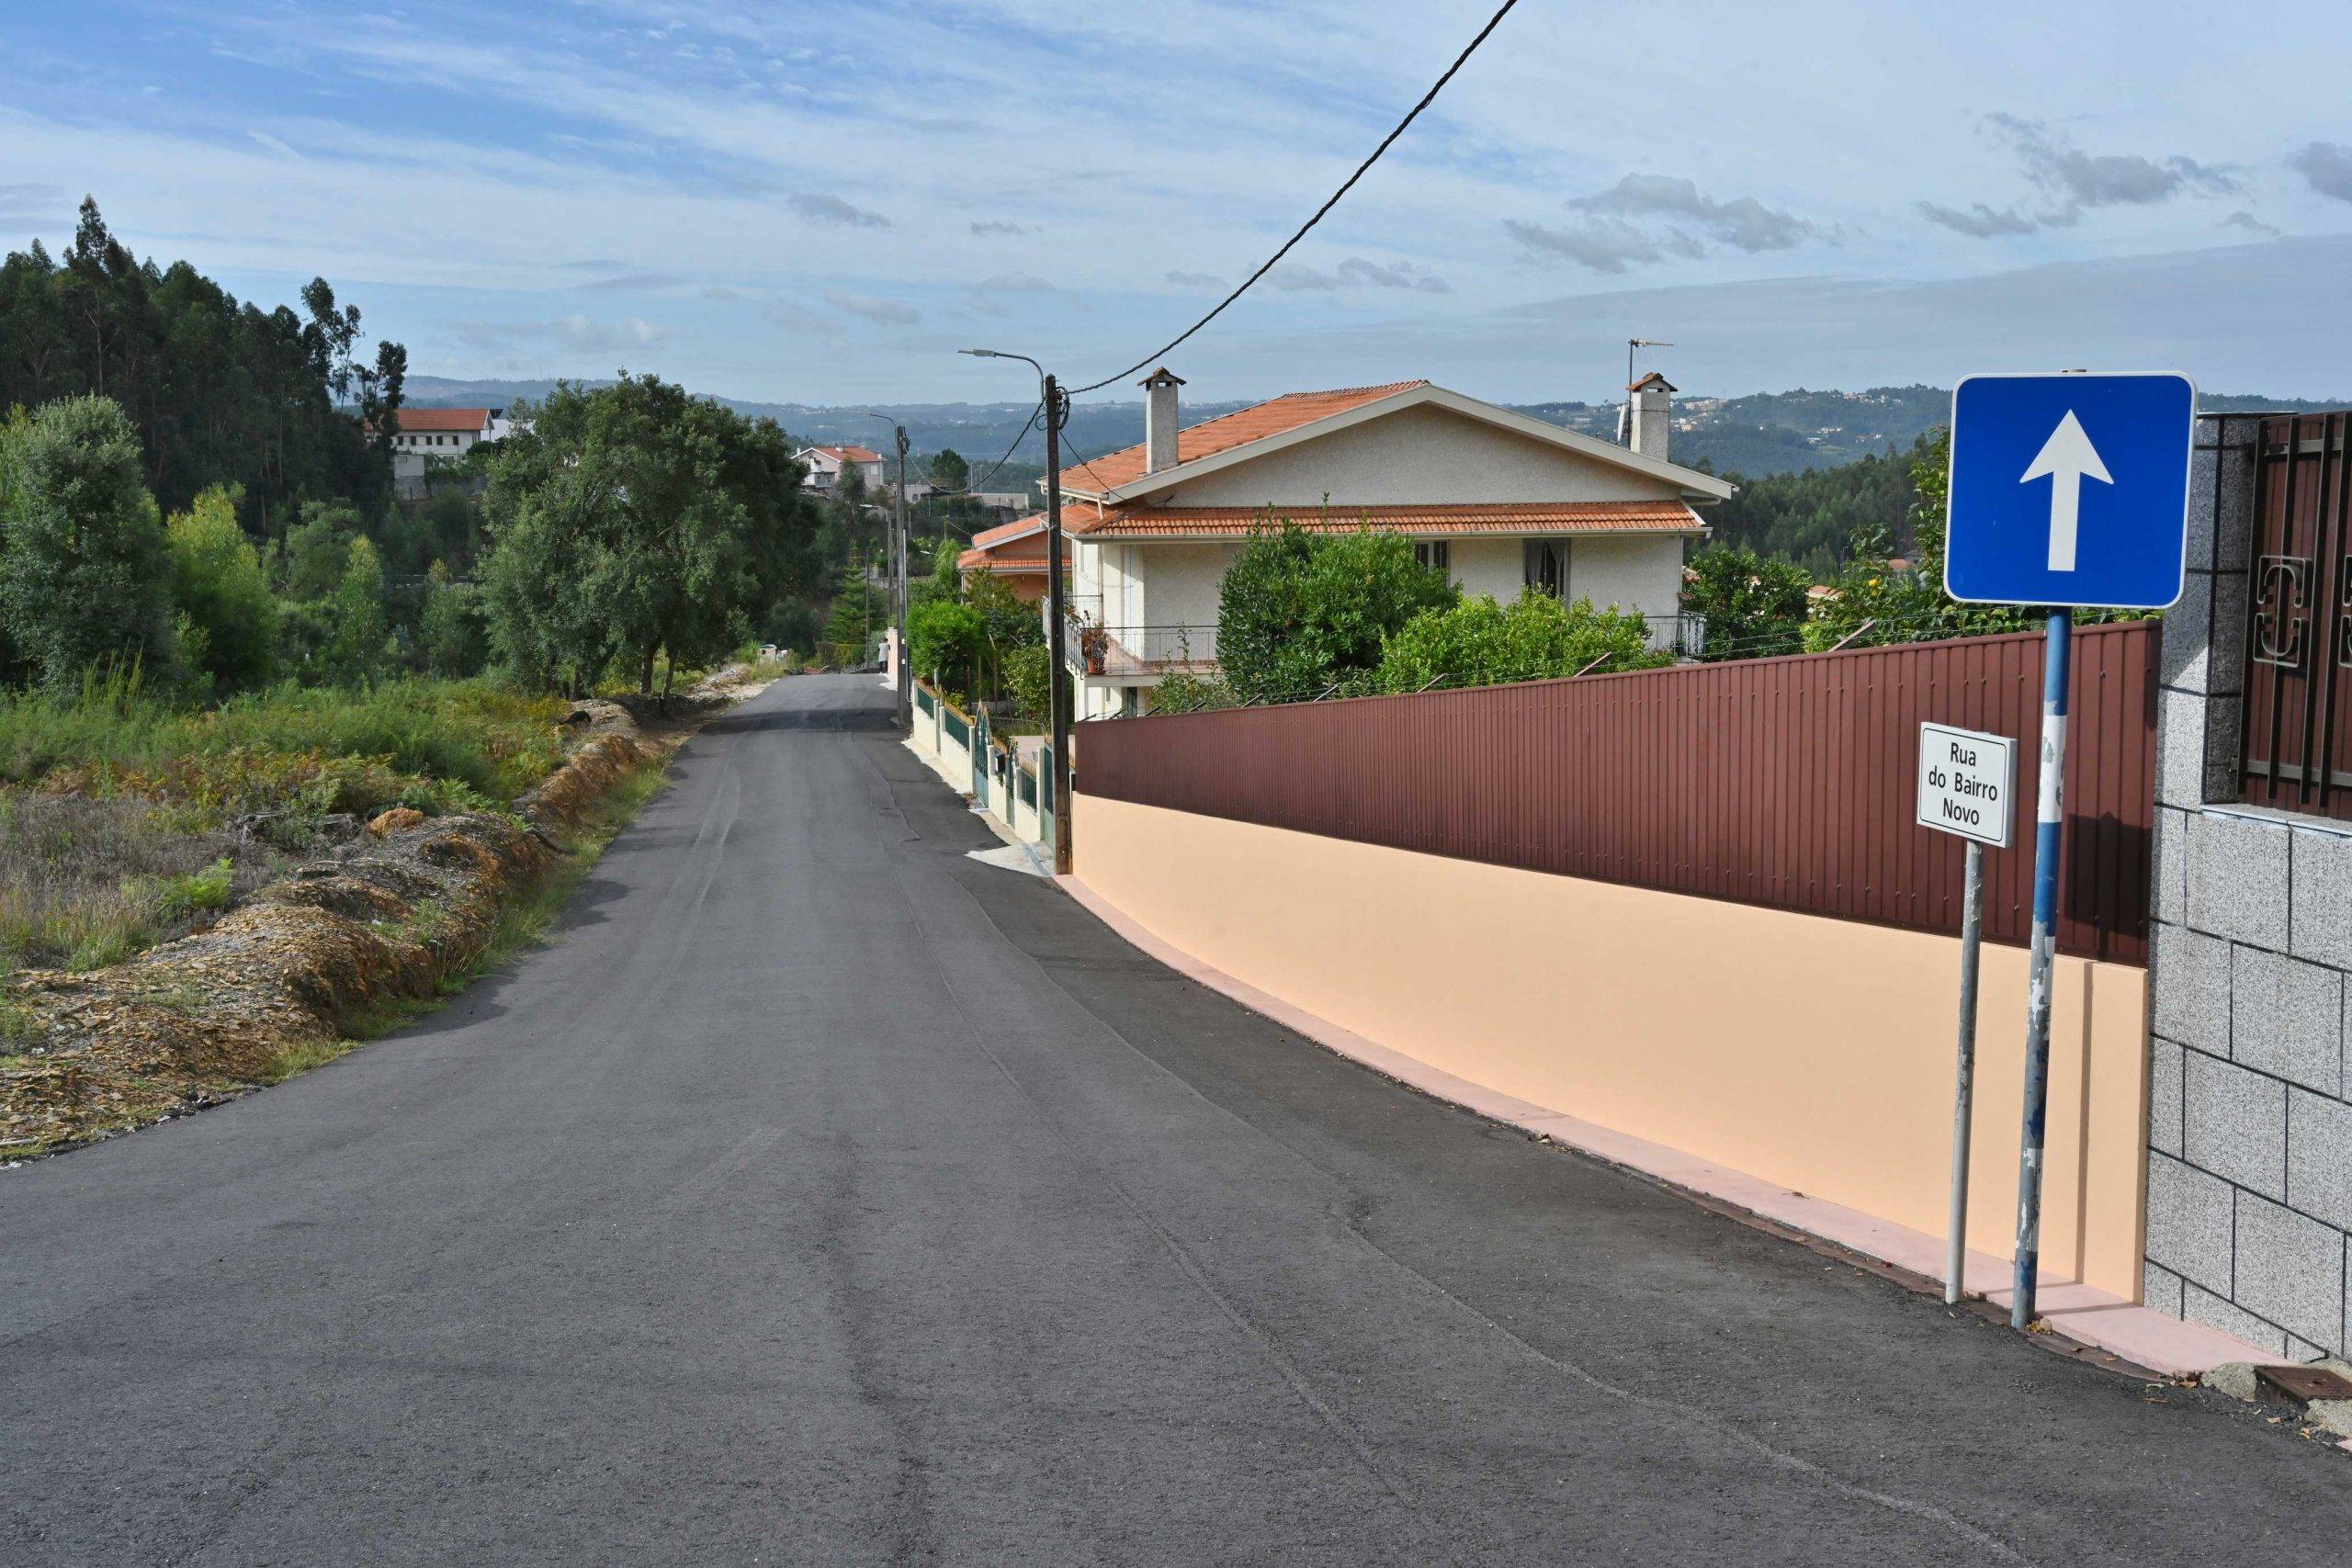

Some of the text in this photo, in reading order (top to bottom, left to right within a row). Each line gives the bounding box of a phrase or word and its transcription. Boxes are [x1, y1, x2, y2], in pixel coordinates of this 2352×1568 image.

[1950, 741, 1976, 767] Rua
[1928, 765, 1997, 801] do Bairro
[1943, 797, 1980, 825] Novo
